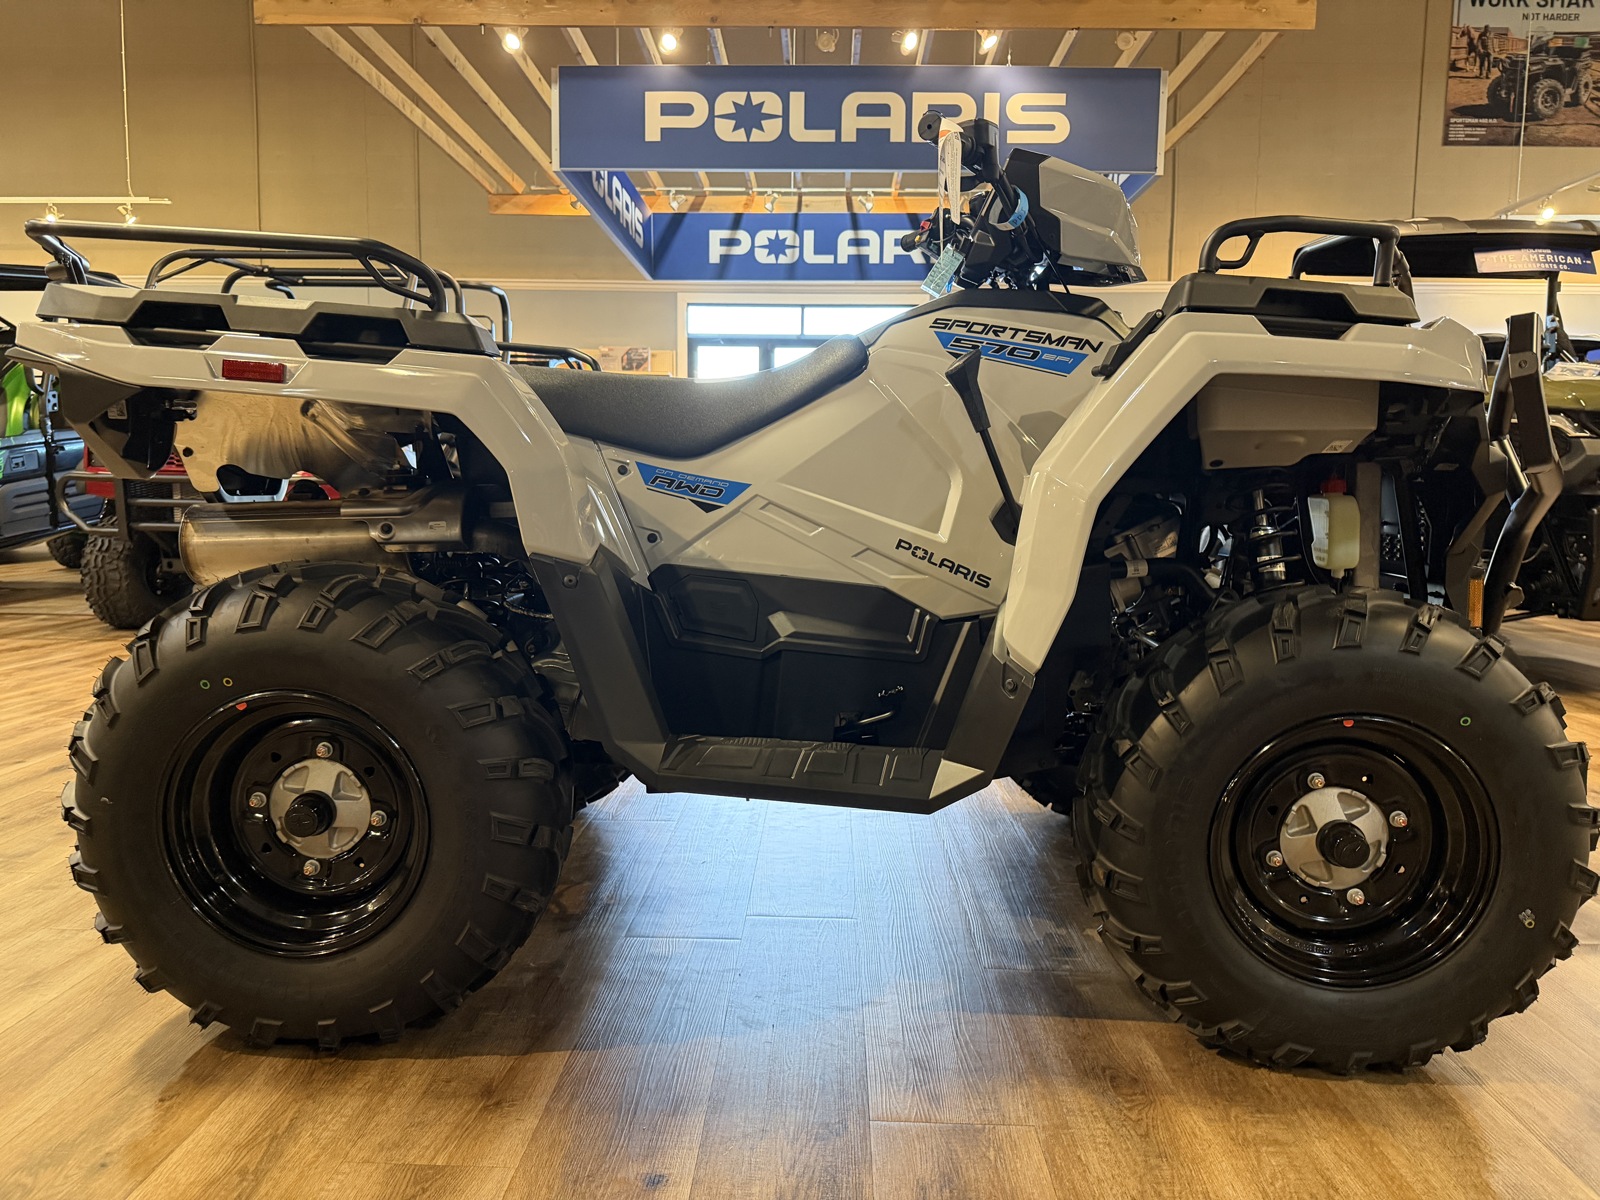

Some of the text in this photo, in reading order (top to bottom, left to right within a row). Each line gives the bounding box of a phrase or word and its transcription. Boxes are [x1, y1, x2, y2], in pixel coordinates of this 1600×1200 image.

[1542, 12, 1580, 21] HARDER
[644, 91, 1071, 144] POLARIS
[591, 170, 644, 249] OLARIS
[708, 229, 937, 264] POLAR
[1492, 254, 1582, 264] THE AMERICAN
[929, 317, 1104, 353] SPORTSMAN
[947, 335, 1074, 364] 570 EFI
[648, 474, 725, 499] AWD
[655, 468, 730, 487] ON DEMAND
[894, 538, 992, 589] POLARIS
